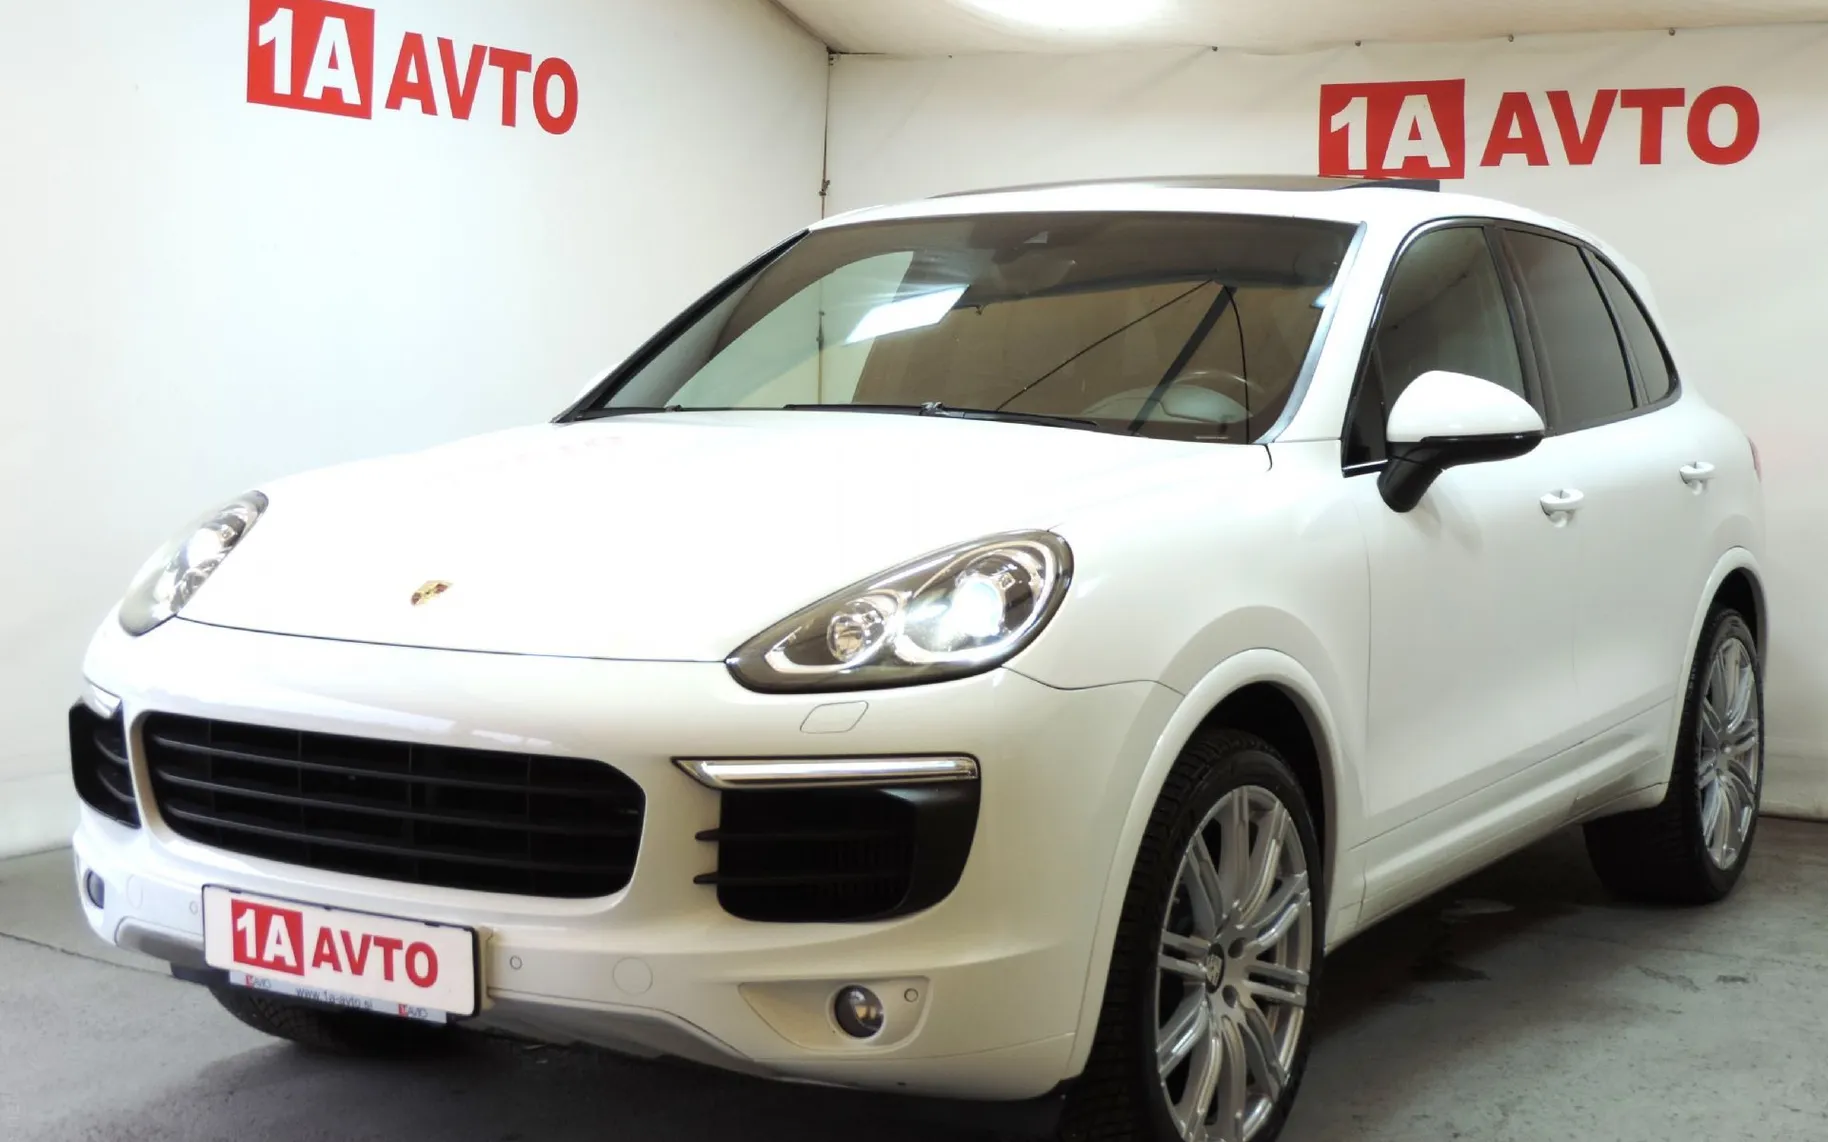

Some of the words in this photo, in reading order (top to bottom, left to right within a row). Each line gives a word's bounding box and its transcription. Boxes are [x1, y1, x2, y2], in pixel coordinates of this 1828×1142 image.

[258, 7, 362, 106] 1A
[384, 31, 579, 135] AVTO
[1330, 93, 1452, 171] 1A
[1479, 86, 1760, 166] AVTO
[236, 908, 298, 968] 1A
[312, 926, 439, 988] AVTO
